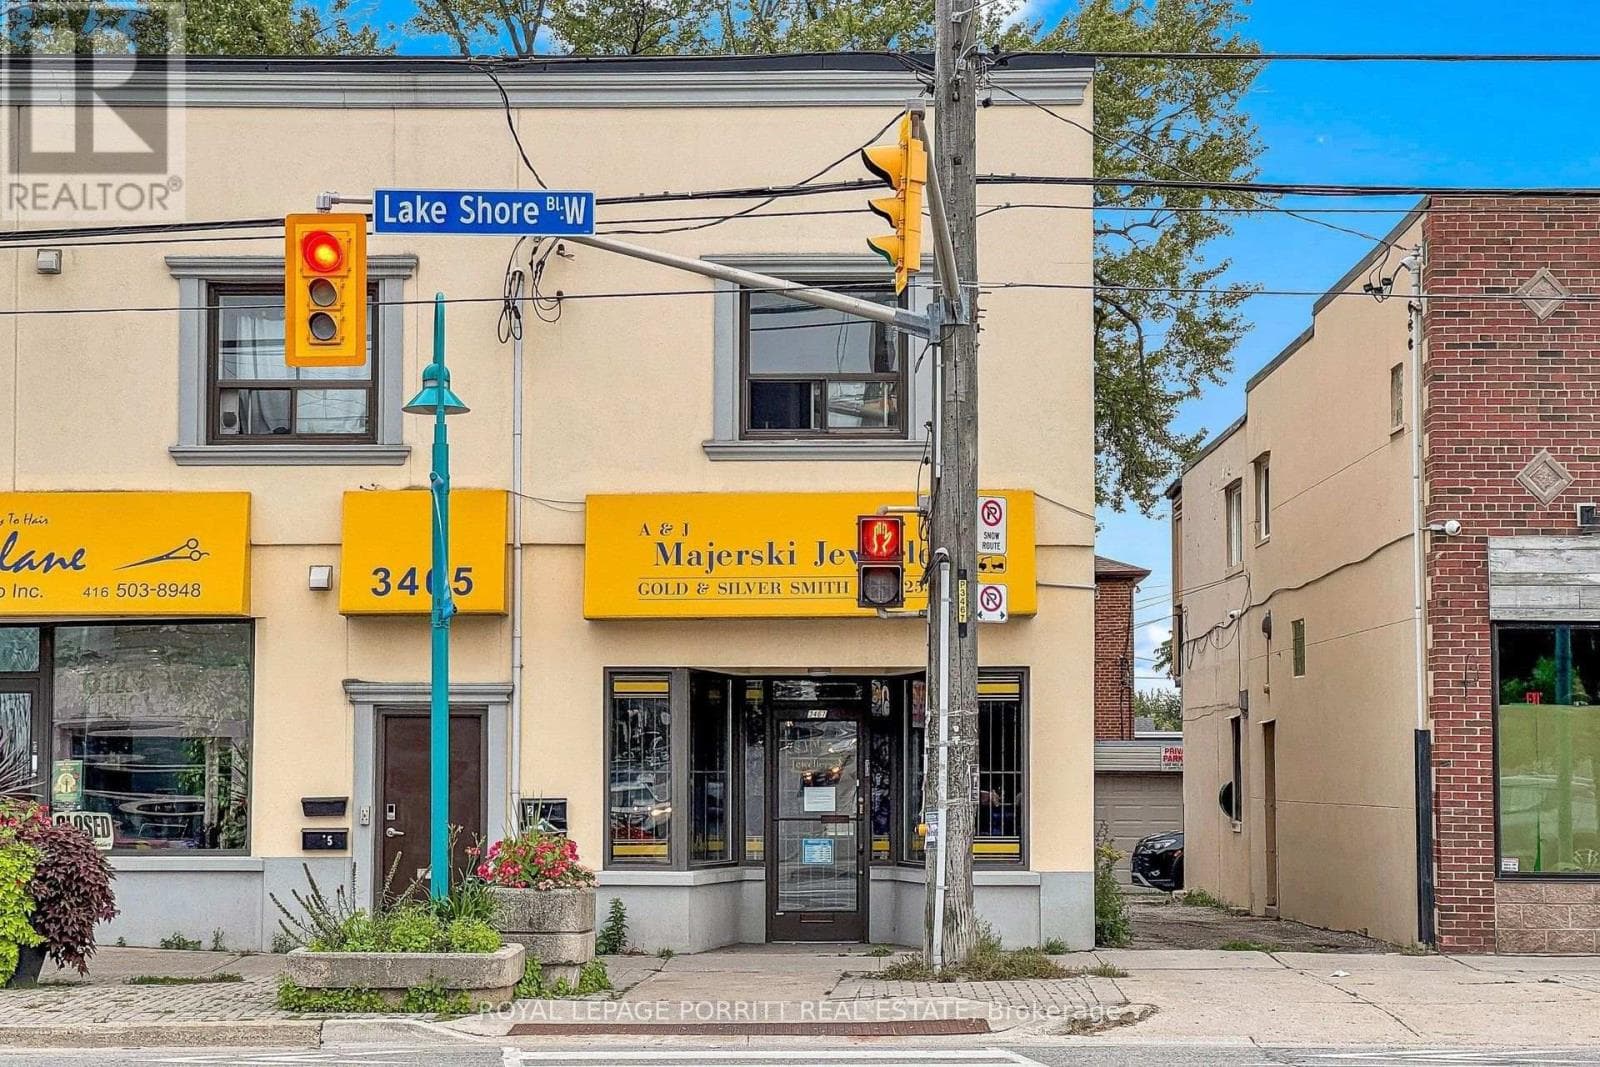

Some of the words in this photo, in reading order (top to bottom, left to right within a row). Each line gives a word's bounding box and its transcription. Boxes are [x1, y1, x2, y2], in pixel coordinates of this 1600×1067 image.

[383, 194, 447, 224] Lake
[459, 195, 540, 225] Shore
[8, 512, 20, 525] To
[23, 512, 48, 525] Hair
[638, 522, 651, 537] A
[659, 522, 673, 537] &
[681, 521, 690, 537] J
[983, 531, 1000, 540] SNOW
[981, 541, 1001, 550] ROUTE
[654, 540, 796, 575] Majerski
[13, 583, 43, 599] Inc.
[83, 586, 109, 598] 416
[116, 583, 201, 599] 503-8948
[637, 582, 689, 596] GOLD
[697, 582, 711, 596] &
[717, 581, 782, 595] SILVER
[790, 581, 850, 595] SMITH
[326, 835, 334, 846] 5
